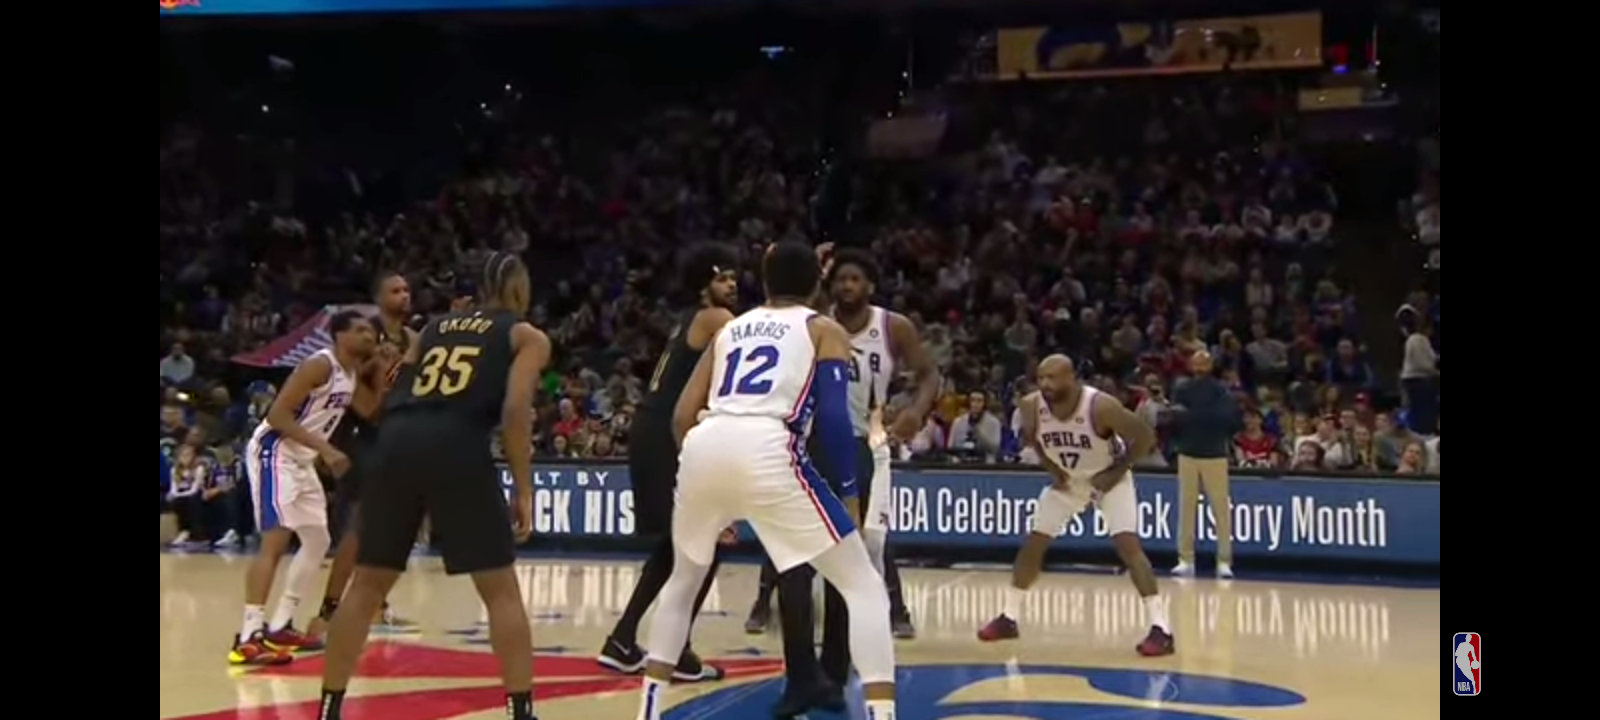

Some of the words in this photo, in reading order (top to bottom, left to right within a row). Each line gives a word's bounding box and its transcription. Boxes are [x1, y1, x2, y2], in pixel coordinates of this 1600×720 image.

[439, 318, 493, 334] OKORO
[731, 321, 791, 343] HARRIS
[412, 345, 481, 396] 35
[718, 345, 780, 397] 12
[1042, 431, 1092, 449] PHILA
[1059, 452, 1080, 470] 17
[502, 470, 561, 486] ULT
[577, 472, 609, 486] BY
[584, 489, 636, 535] HIS
[937, 487, 1084, 537] Celebras
[1291, 496, 1387, 547] Month
